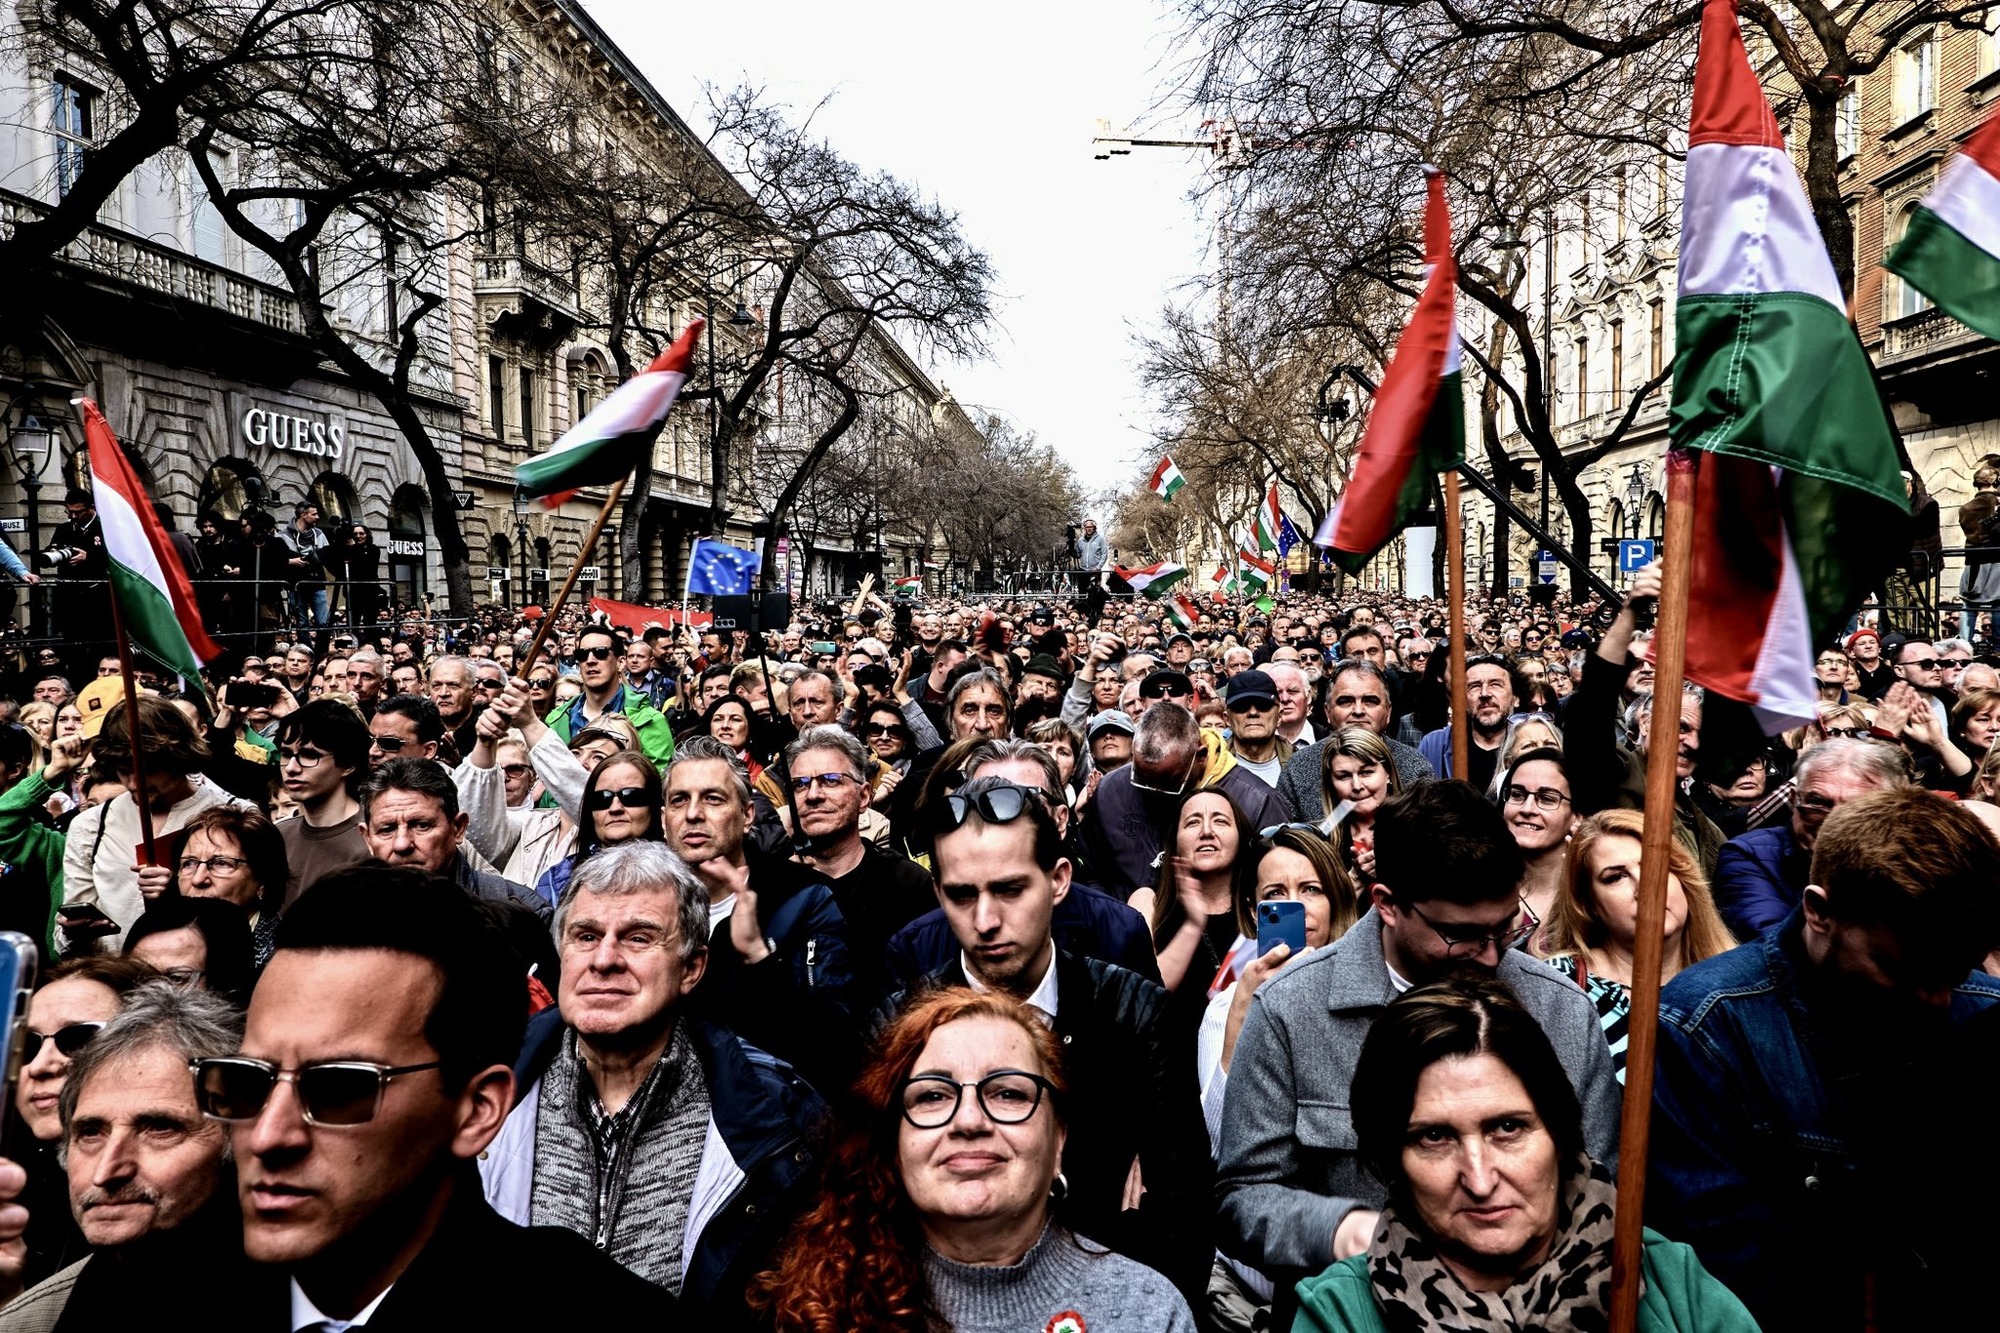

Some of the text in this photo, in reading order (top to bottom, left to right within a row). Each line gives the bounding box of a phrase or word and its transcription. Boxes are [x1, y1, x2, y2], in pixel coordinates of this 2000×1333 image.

[243, 408, 343, 459] GUESS
[386, 540, 424, 556] GUESS
[1627, 544, 1646, 568] P
